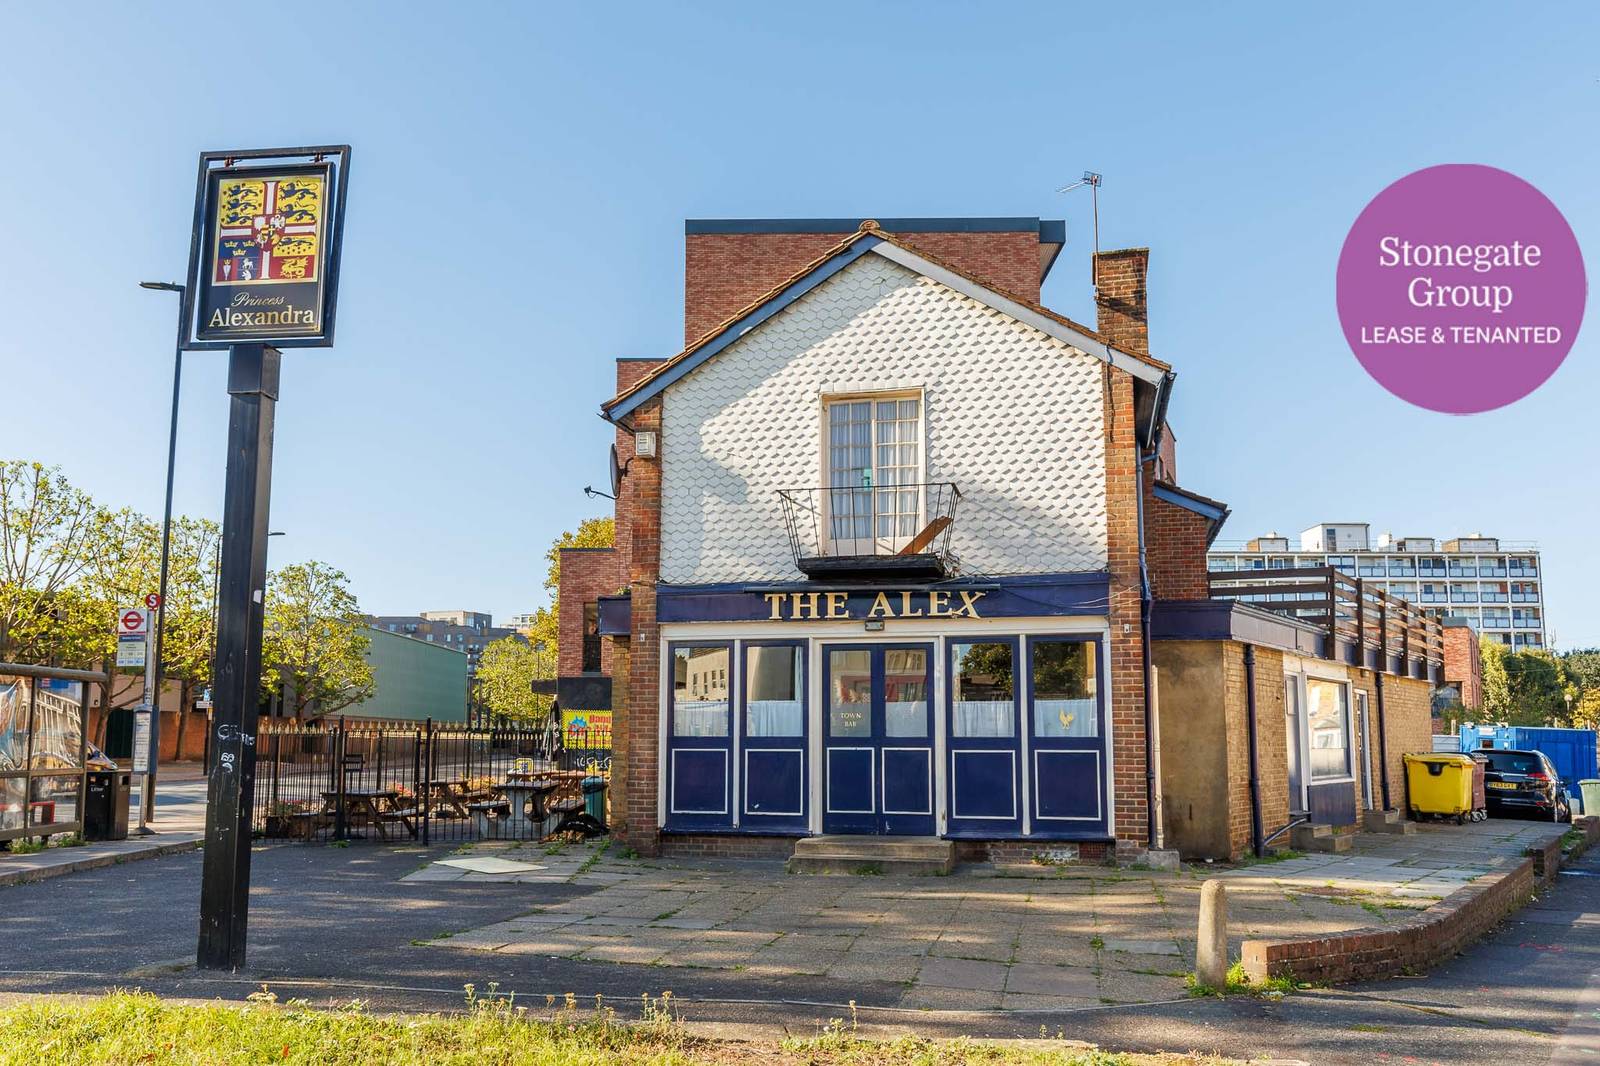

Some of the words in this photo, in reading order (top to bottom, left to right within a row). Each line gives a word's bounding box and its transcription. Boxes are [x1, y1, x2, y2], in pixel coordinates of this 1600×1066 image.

[231, 291, 285, 307] Princess
[208, 305, 314, 328] Alexandra
[148, 594, 157, 606] S
[764, 592, 849, 620] THE
[867, 591, 987, 619] ALEX
